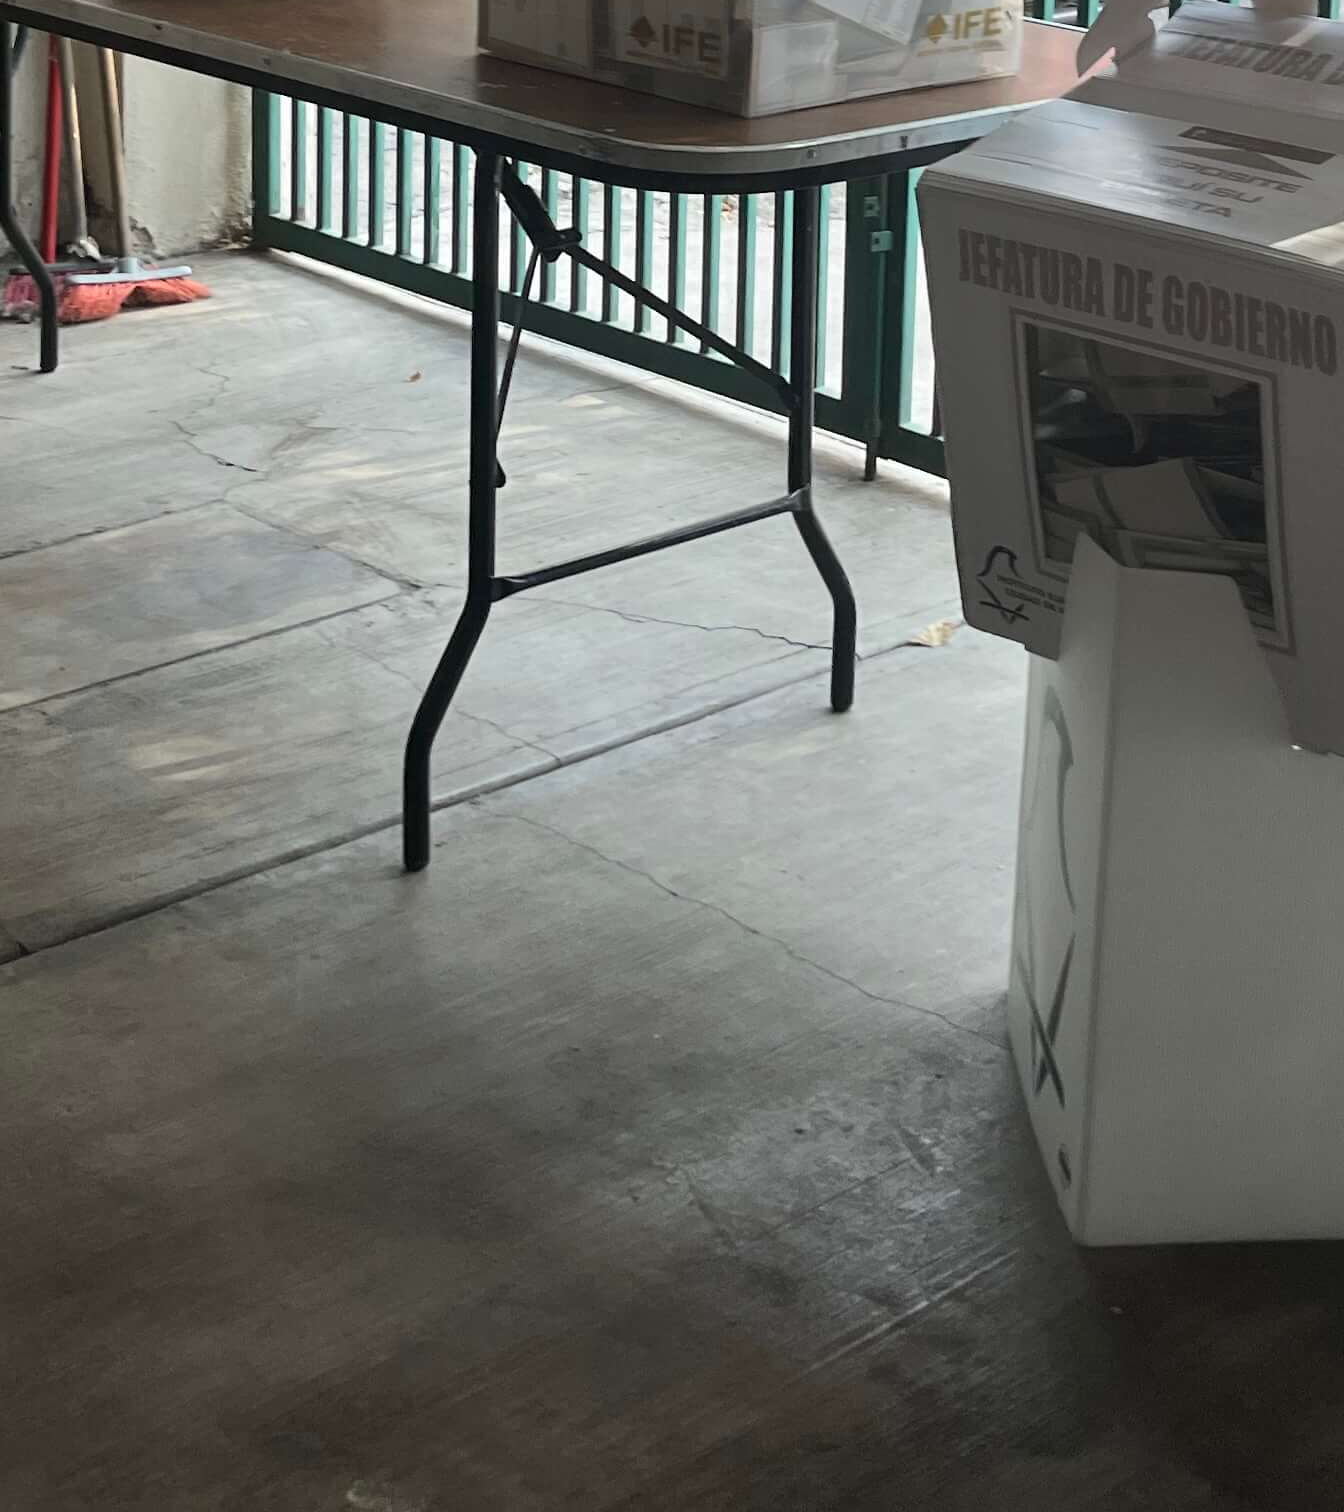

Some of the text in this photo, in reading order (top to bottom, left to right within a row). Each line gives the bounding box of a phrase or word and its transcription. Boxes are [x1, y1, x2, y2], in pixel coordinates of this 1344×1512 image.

[662, 23, 723, 65] IFE
[954, 7, 1003, 39] IFE
[957, 227, 1338, 377] JEFATURA DE GOBIERNO
